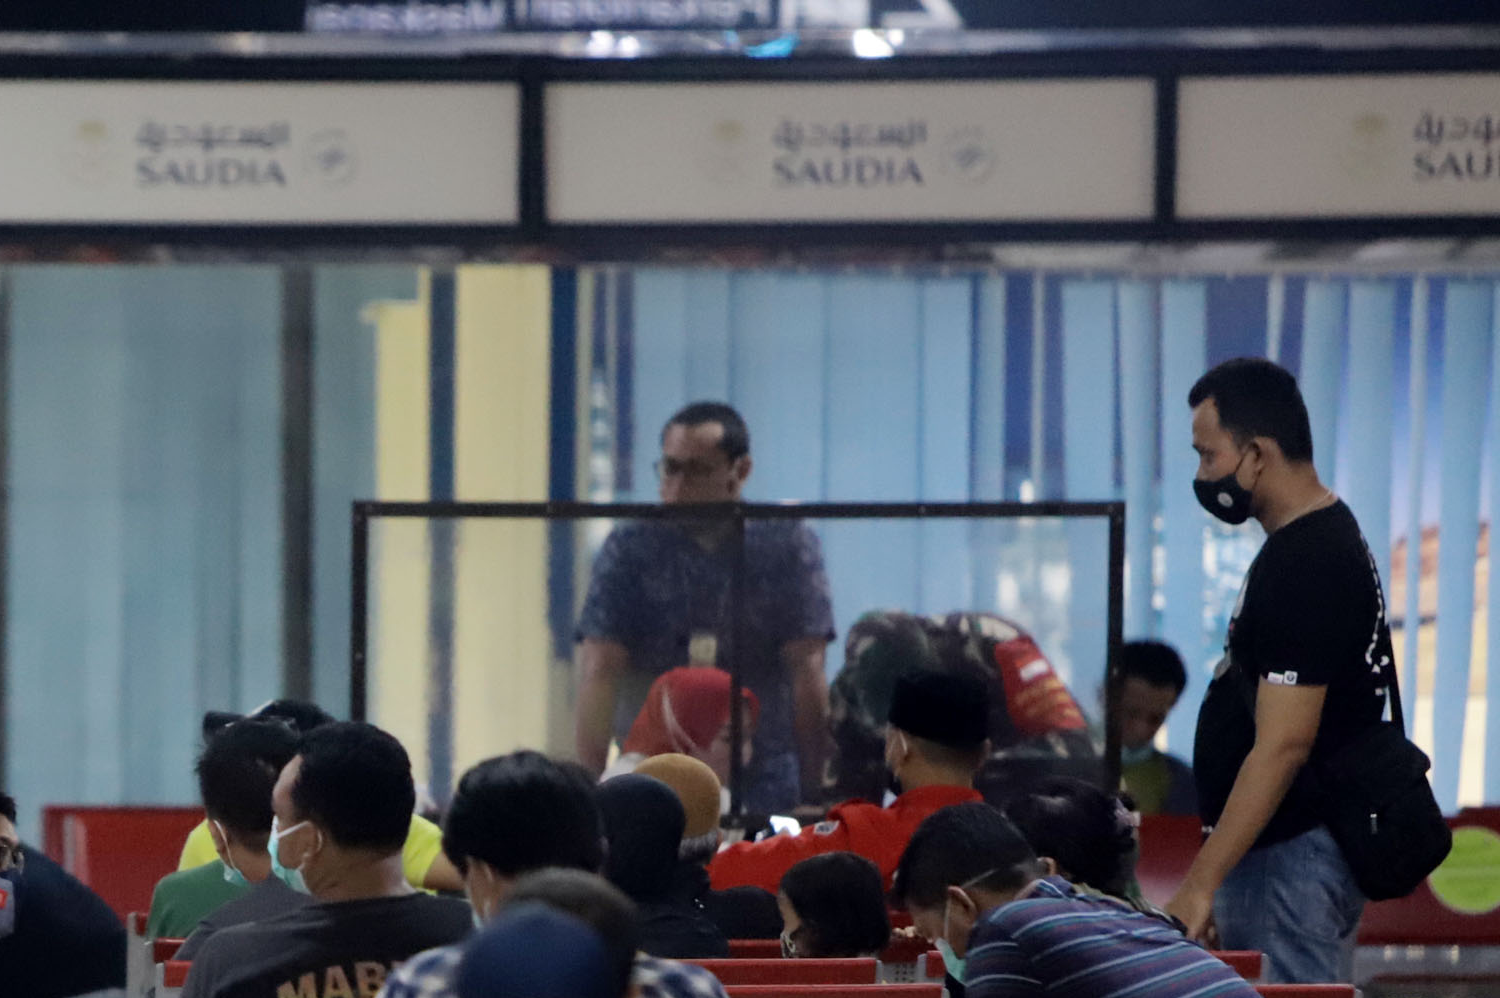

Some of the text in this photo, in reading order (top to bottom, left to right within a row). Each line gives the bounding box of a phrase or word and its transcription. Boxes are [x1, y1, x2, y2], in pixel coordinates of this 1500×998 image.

[136, 157, 287, 186] SAUDIA
[773, 156, 924, 185] SAUDIA
[1413, 152, 1500, 182] SAU
